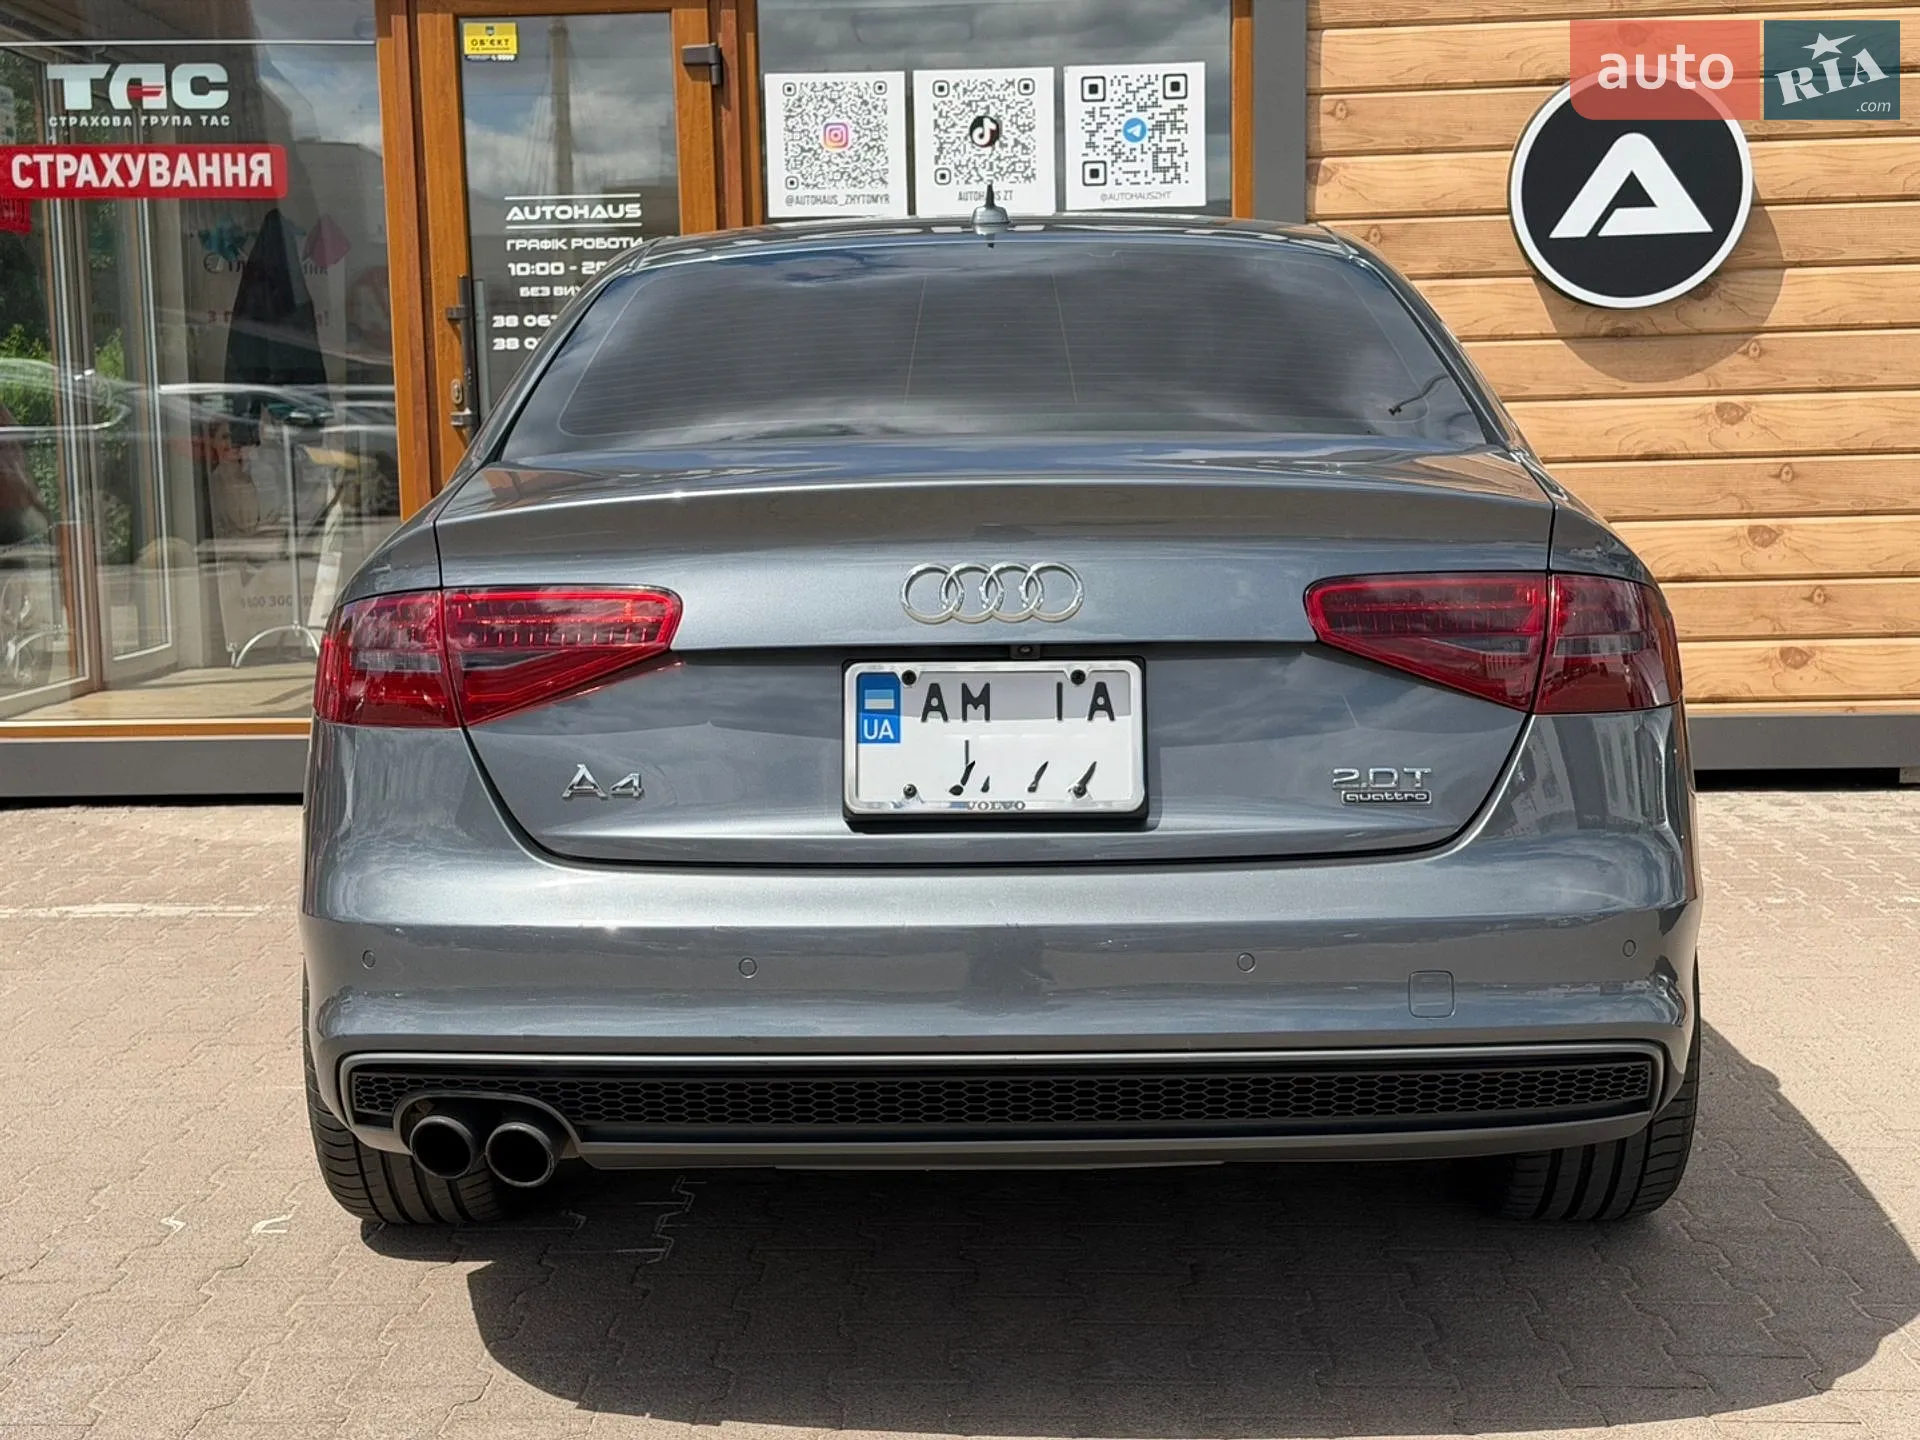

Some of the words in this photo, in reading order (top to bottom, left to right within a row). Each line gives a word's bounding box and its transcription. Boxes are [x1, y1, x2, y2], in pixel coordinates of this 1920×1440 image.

[49, 116, 132, 128] СТРАХОВА
[141, 115, 193, 127] ГРУПА
[200, 115, 231, 127] ТАС
[11, 153, 273, 189] СТРАХУВАННЯ
[958, 190, 1002, 202] AUTOHS
[506, 203, 642, 220] AUTOHAUS
[506, 238, 568, 251] ГРАФІК
[571, 236, 644, 250] РОБОТИ
[508, 261, 565, 276] 10:00
[519, 286, 550, 297] БЕЗ
[920, 682, 991, 722] AM
[863, 719, 895, 740] UA
[562, 763, 644, 799] A4
[1332, 767, 1432, 788] 2.0T
[1346, 791, 1428, 803] quattro
[967, 800, 1026, 811] VOLVO
